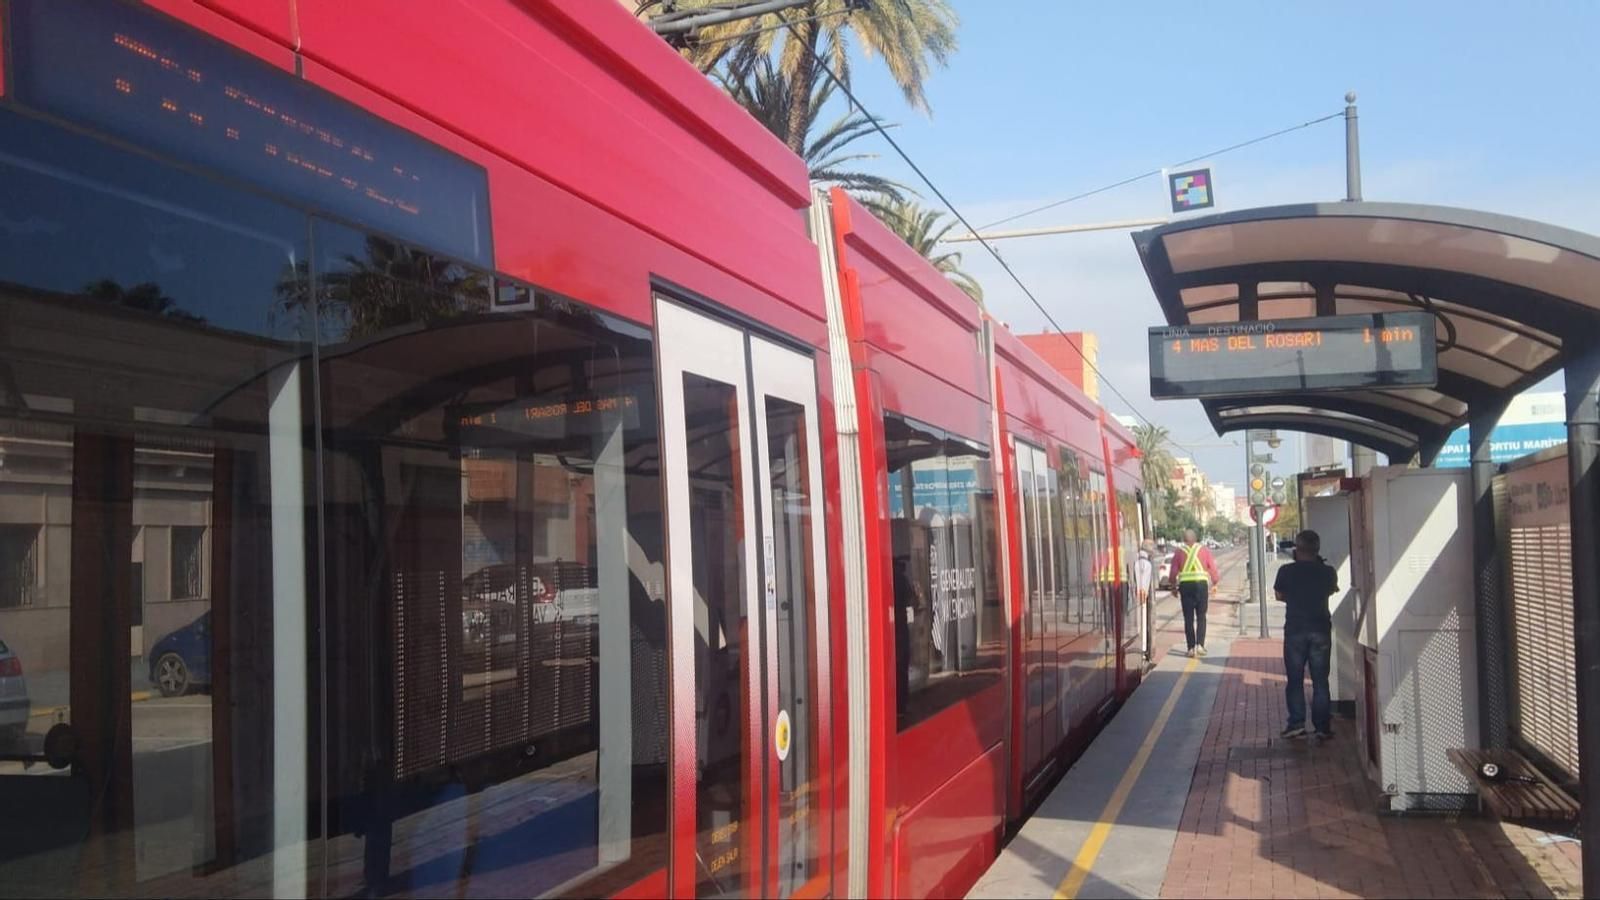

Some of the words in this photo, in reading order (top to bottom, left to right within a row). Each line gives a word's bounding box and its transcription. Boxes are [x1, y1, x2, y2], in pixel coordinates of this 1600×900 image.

[1171, 339, 1182, 353] 4
[1190, 337, 1219, 352] MAS
[1227, 333, 1257, 351] DEL
[1265, 330, 1322, 347] ROSARI
[1363, 327, 1372, 343] 1
[1381, 326, 1414, 343] min
[1440, 444, 1464, 454] SPAI
[940, 567, 975, 592] GENERALITAT
[939, 592, 975, 622] VALENCIANA
